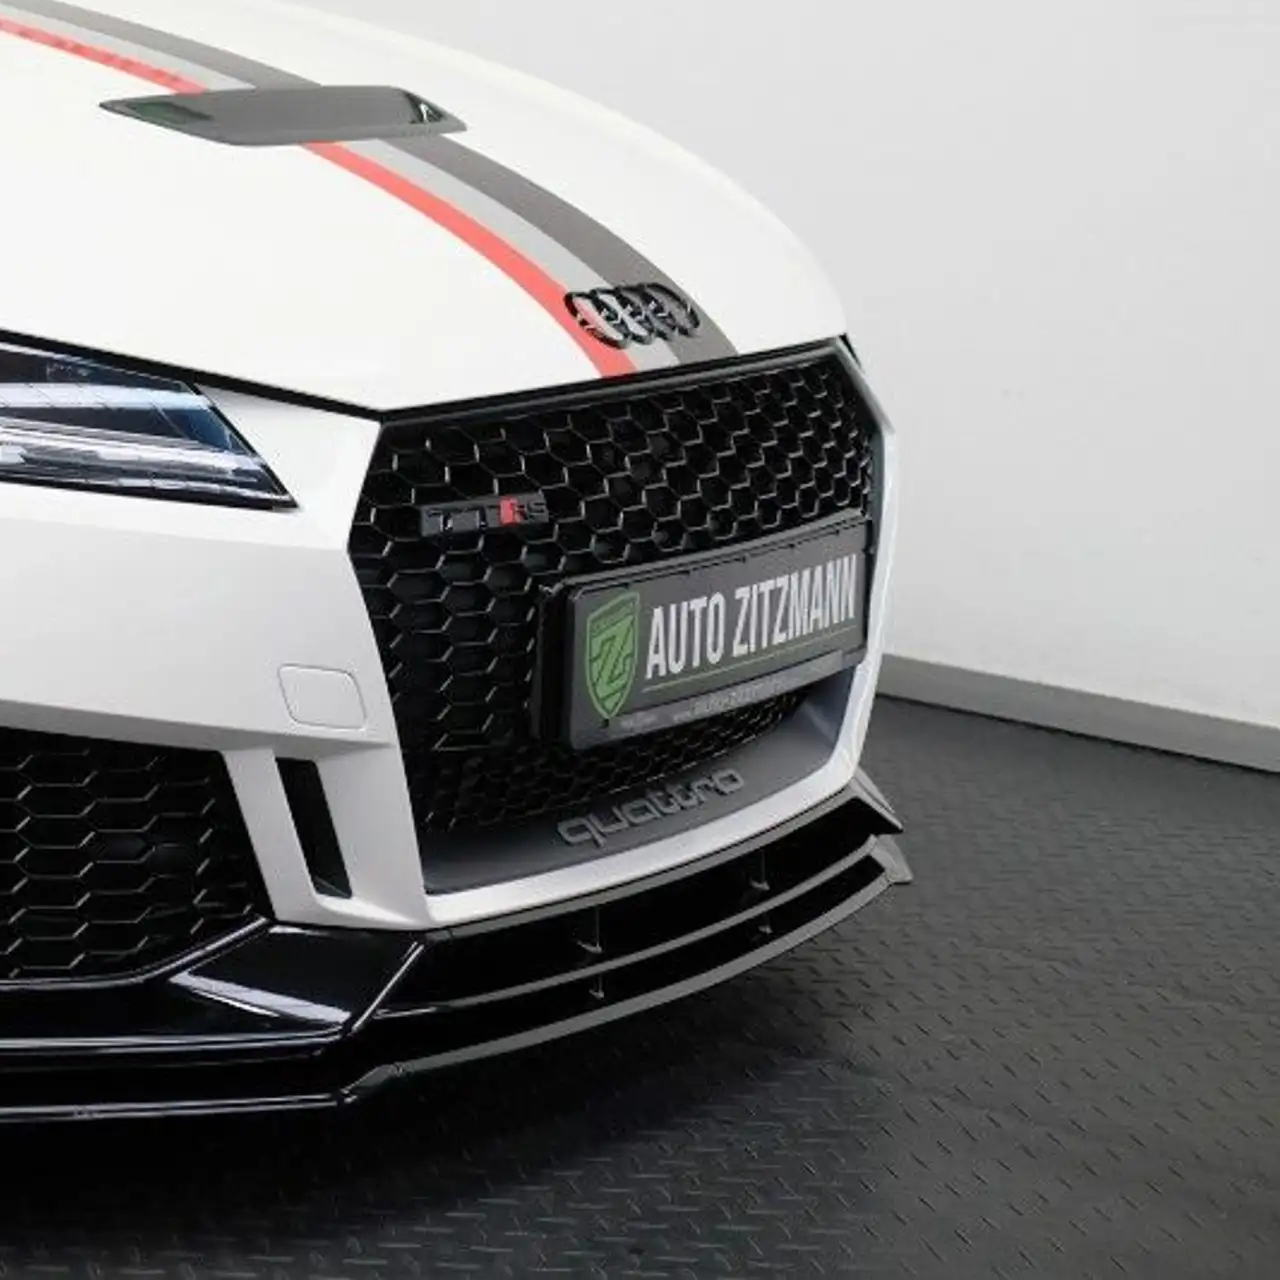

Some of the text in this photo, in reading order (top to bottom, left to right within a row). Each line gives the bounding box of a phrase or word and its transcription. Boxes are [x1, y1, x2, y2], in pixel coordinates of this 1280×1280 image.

[645, 553, 858, 679] AUTO ZITZMANN
[556, 767, 745, 848] quattro
